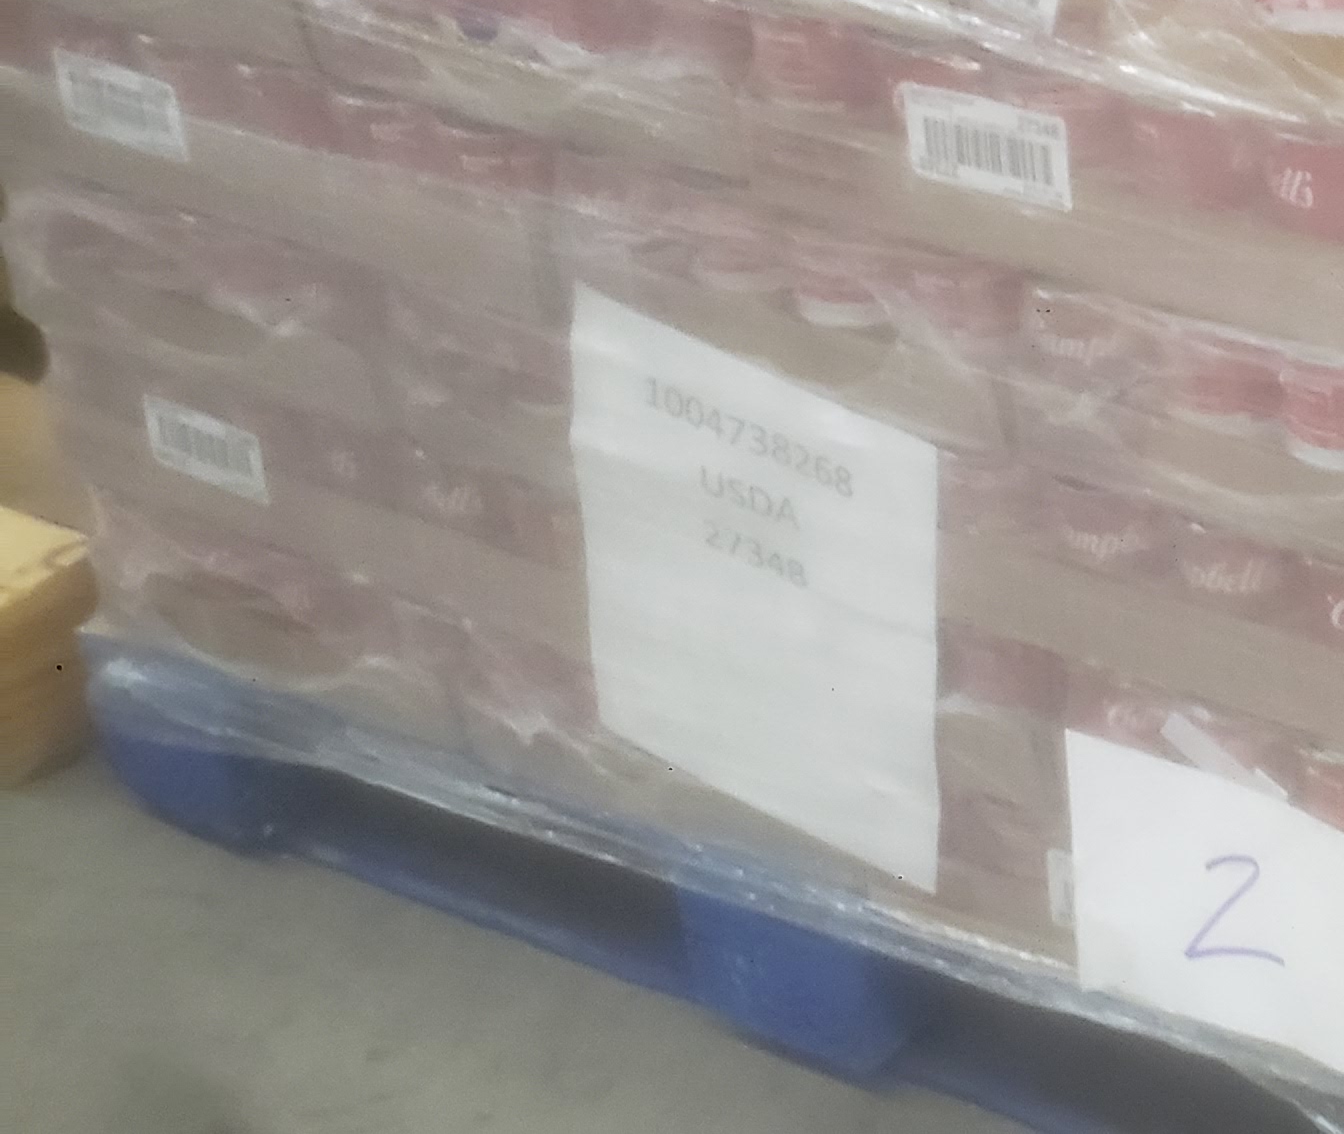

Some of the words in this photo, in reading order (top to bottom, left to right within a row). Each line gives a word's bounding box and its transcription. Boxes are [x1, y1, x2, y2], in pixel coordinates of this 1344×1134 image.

[645, 376, 854, 499] 1004738268
[700, 464, 801, 531] USDA
[704, 518, 808, 588] 27348
[1183, 853, 1286, 968] 2
